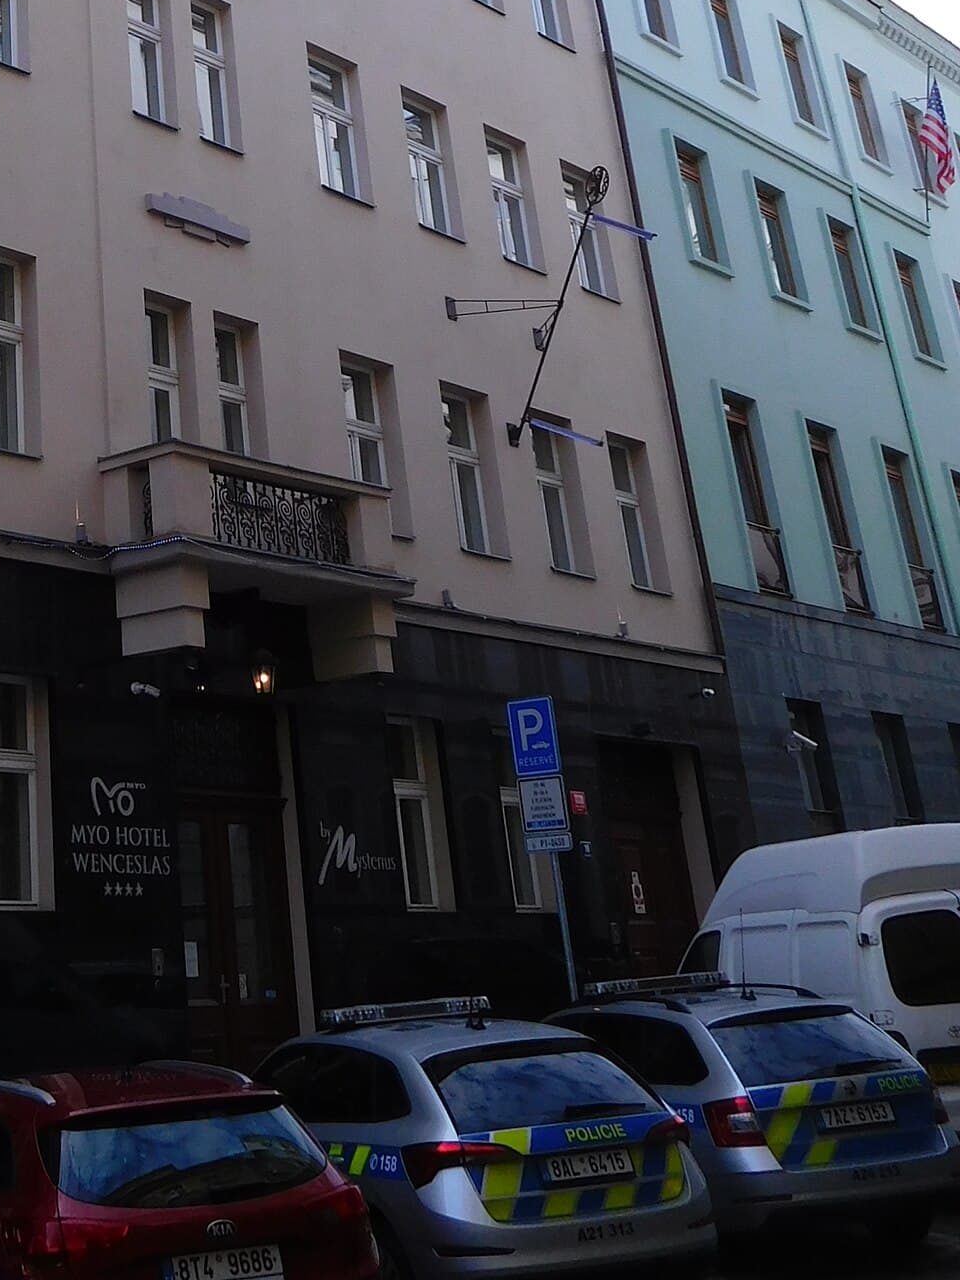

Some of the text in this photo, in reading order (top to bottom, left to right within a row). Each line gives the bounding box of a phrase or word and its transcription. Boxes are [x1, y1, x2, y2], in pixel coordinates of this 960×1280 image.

[517, 708, 544, 751] P
[71, 824, 171, 848] MYO HOTEL
[72, 852, 172, 876] WENCESLAS
[877, 1073, 921, 1093] POLICIE
[564, 1123, 627, 1142] POLICIE
[380, 1153, 398, 1173] 158
[551, 1151, 626, 1178] 8AL 6415
[210, 1222, 234, 1238] KIA
[178, 1247, 275, 1280] 8T4 9686
